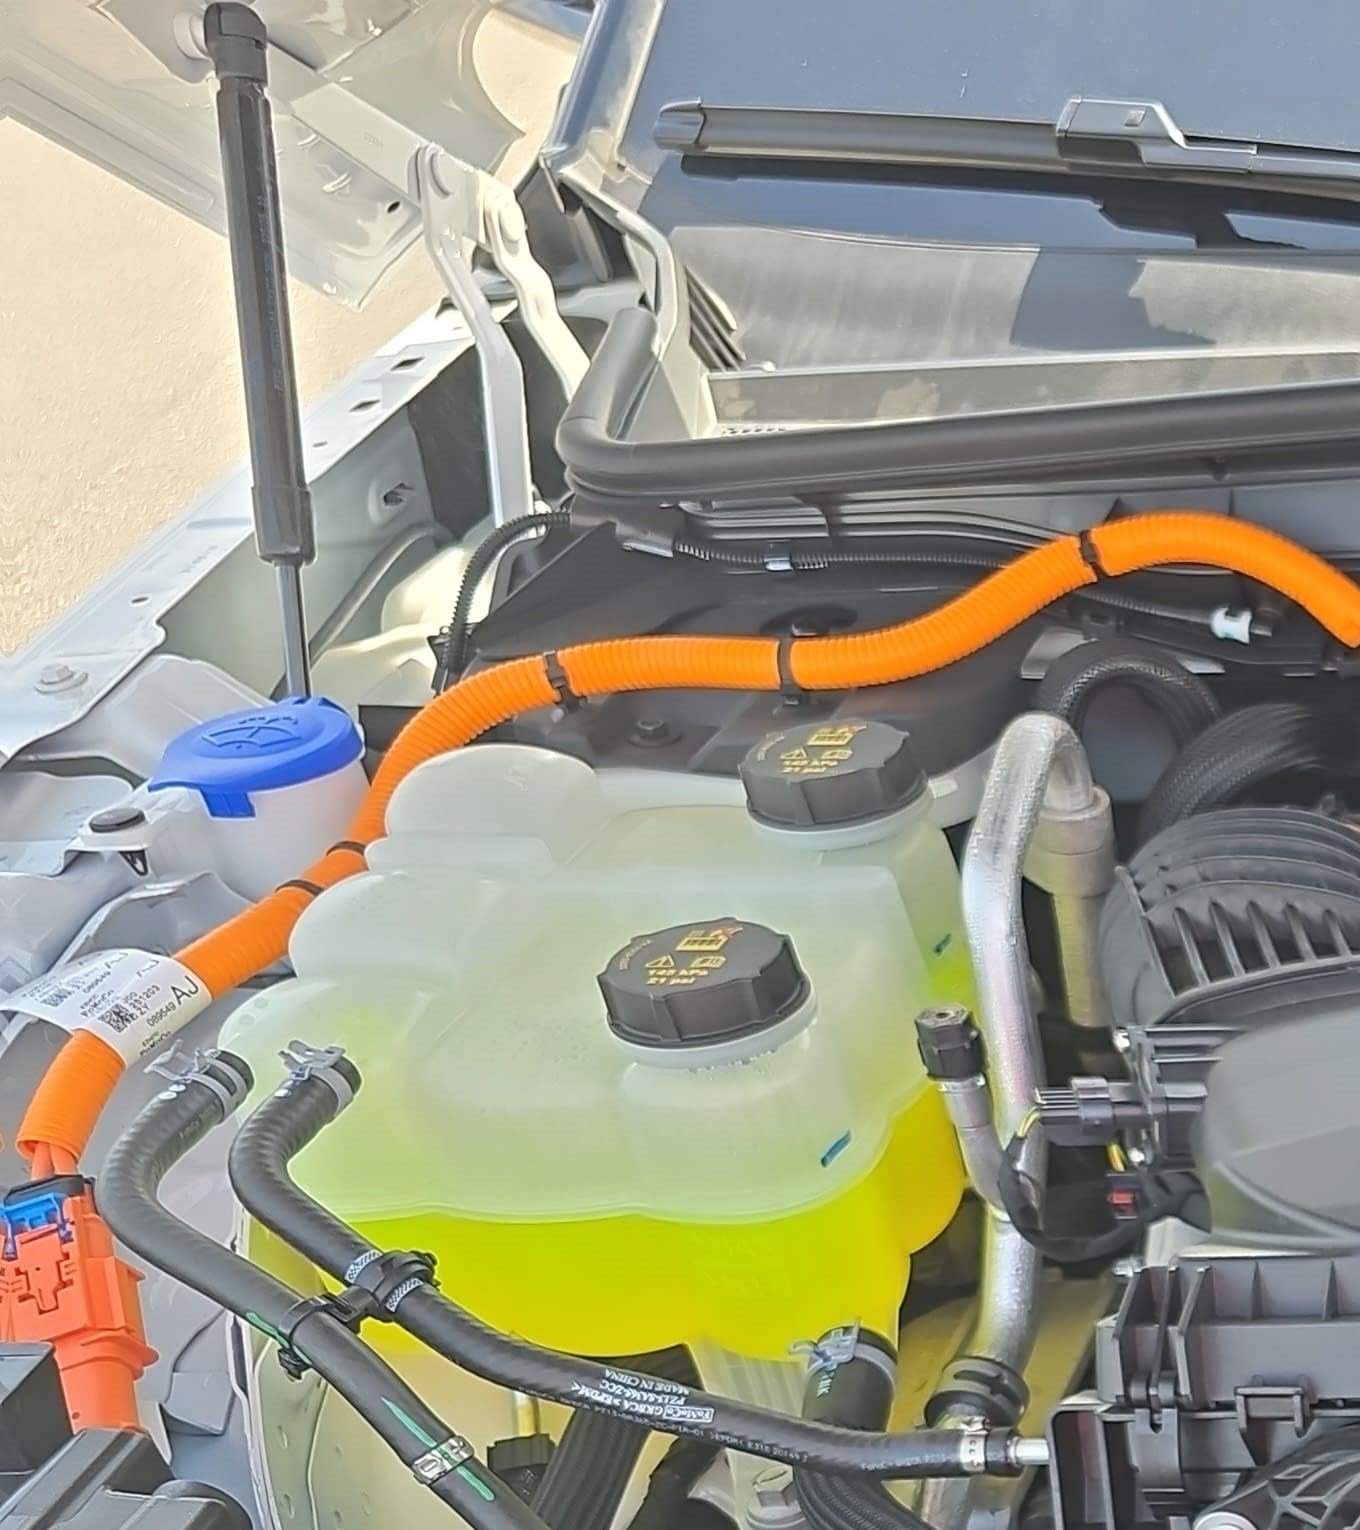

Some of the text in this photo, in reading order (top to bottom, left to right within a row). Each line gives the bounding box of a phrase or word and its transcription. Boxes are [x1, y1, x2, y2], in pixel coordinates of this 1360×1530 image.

[169, 975, 201, 1006] AJ
[605, 1368, 640, 1387] CHINA
[640, 1378, 654, 1390] IN
